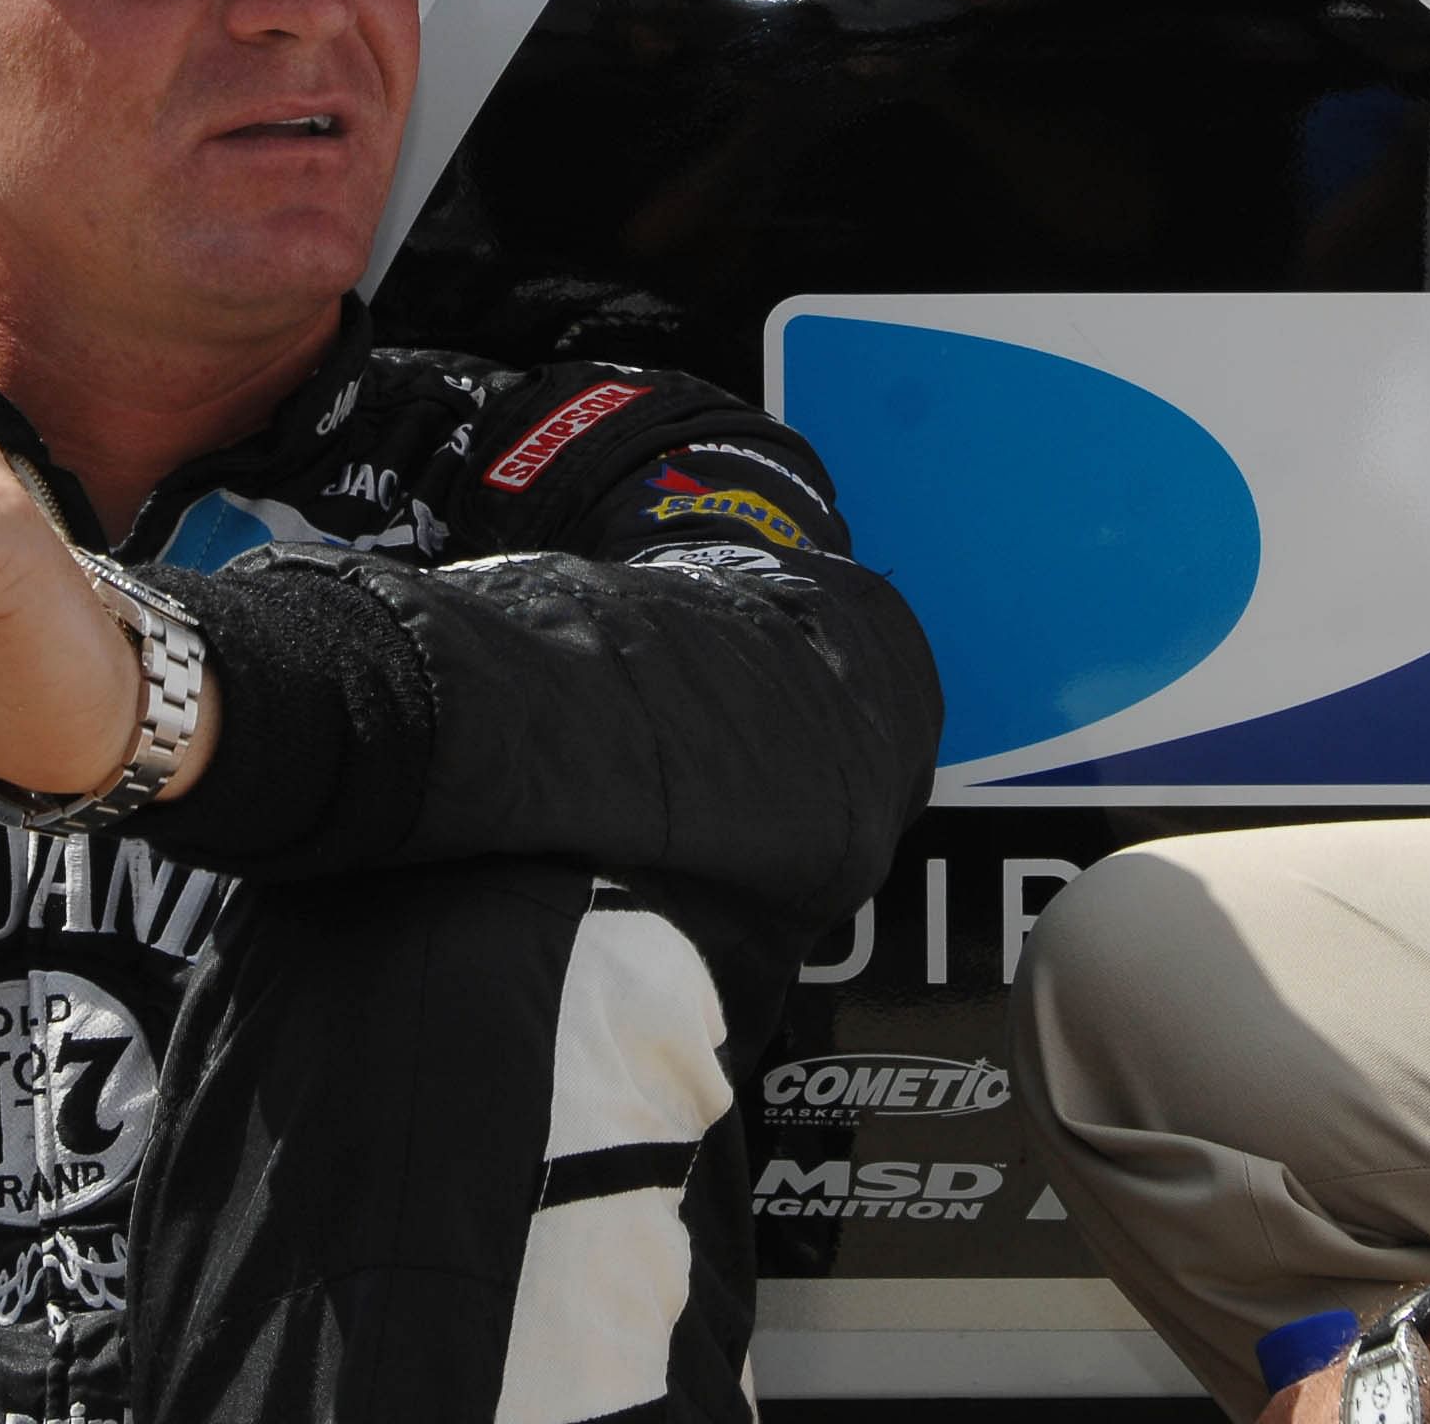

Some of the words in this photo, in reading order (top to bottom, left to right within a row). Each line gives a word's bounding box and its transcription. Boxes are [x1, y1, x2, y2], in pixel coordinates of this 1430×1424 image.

[498, 388, 633, 482] SIMPSON
[763, 1064, 1011, 1110] COMETIC
[764, 1107, 860, 1118] GASKET
[752, 1160, 1004, 1200] MSD
[752, 1198, 984, 1220] IGNITION
